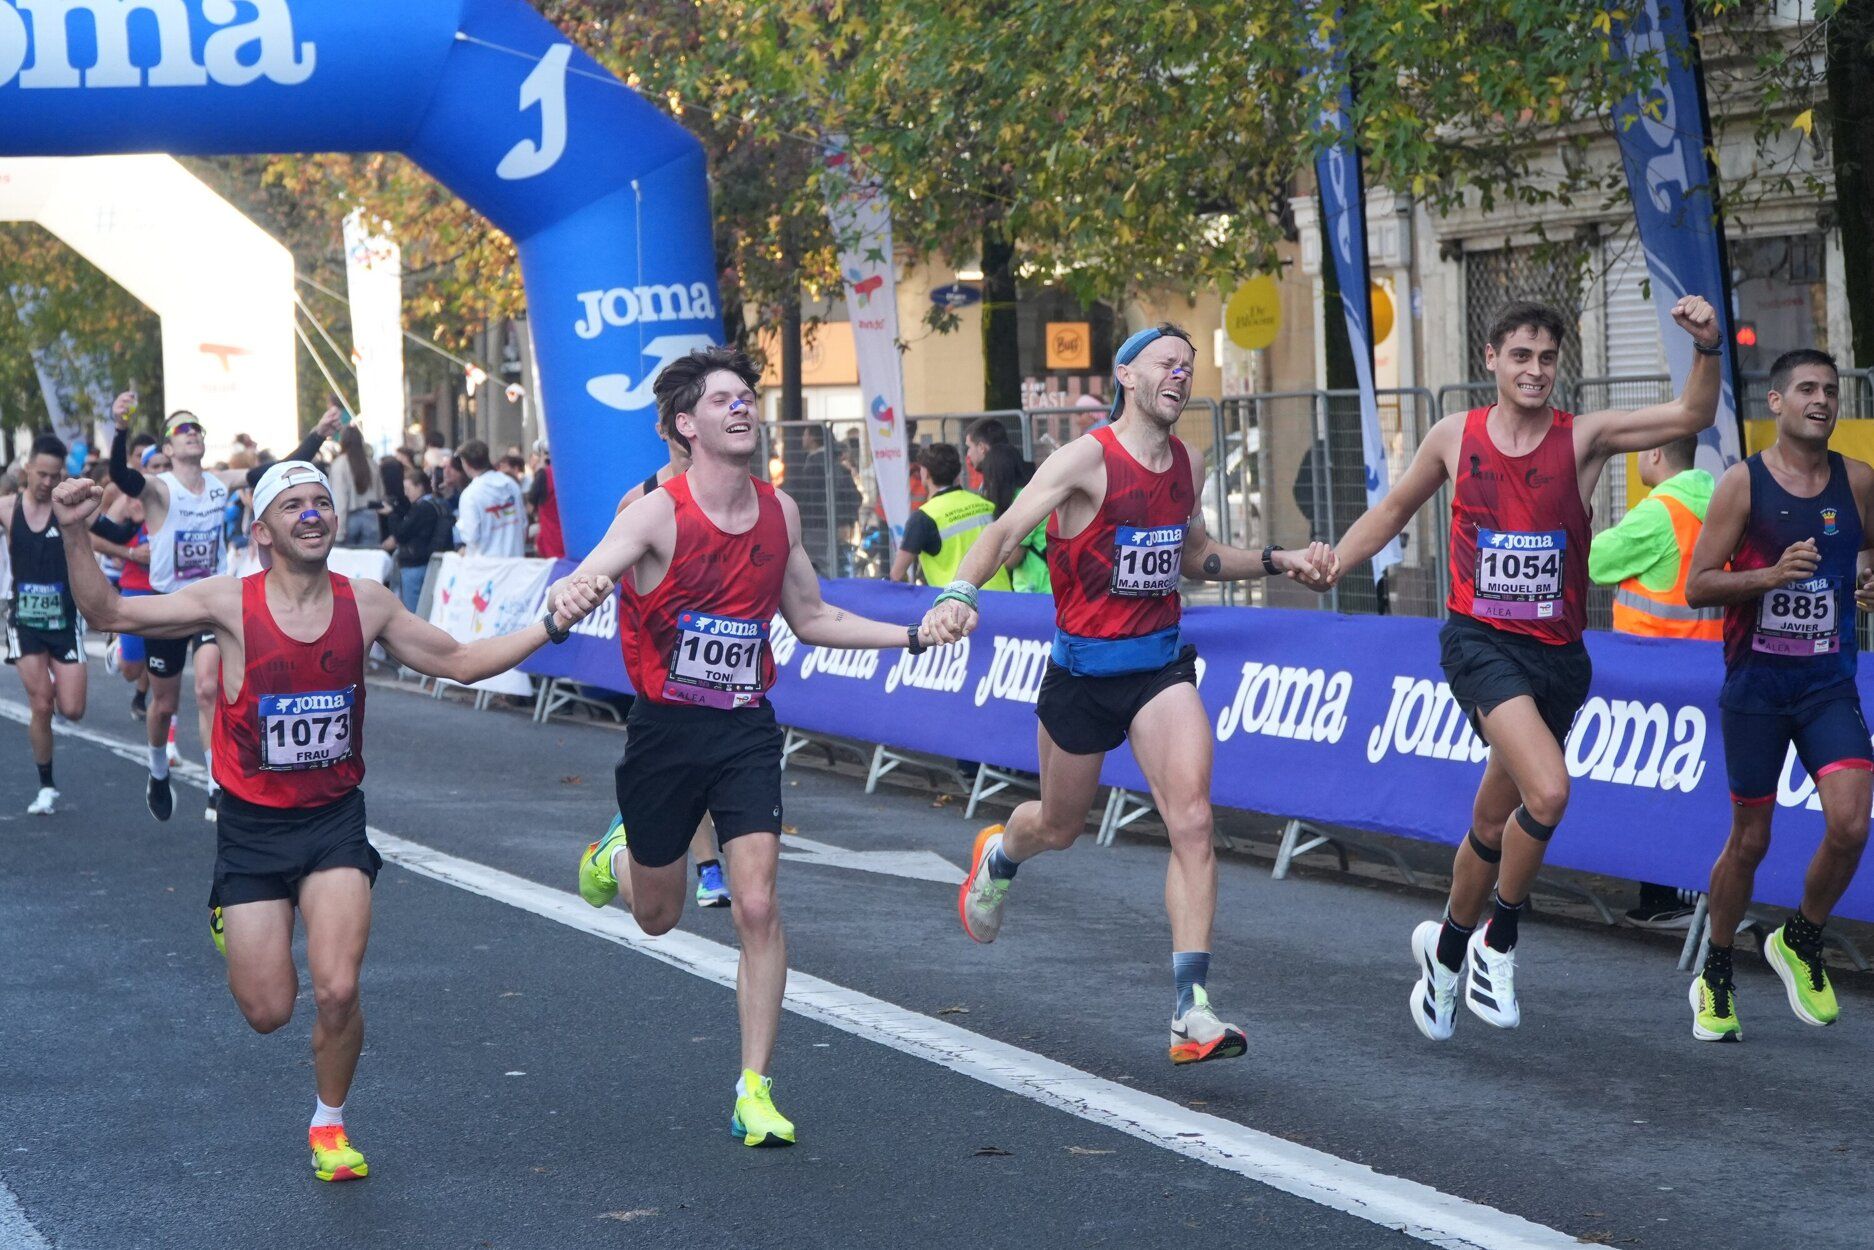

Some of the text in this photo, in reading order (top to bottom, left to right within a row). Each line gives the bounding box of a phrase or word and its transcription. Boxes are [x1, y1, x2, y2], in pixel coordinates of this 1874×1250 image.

[0, 0, 316, 88] ma
[1123, 547, 1182, 575] 1087
[1485, 553, 1557, 579] 1054
[1488, 583, 1551, 592] MIQUEL BM
[20, 595, 59, 609] 1784
[1771, 593, 1828, 619] 885
[1780, 622, 1818, 631] JAVIER
[684, 636, 756, 668] 1061
[705, 670, 733, 682] TONI
[975, 636, 1052, 707] Jom
[270, 713, 349, 747] 1073
[297, 750, 329, 761] FRAU
[1565, 696, 1707, 793] oma
